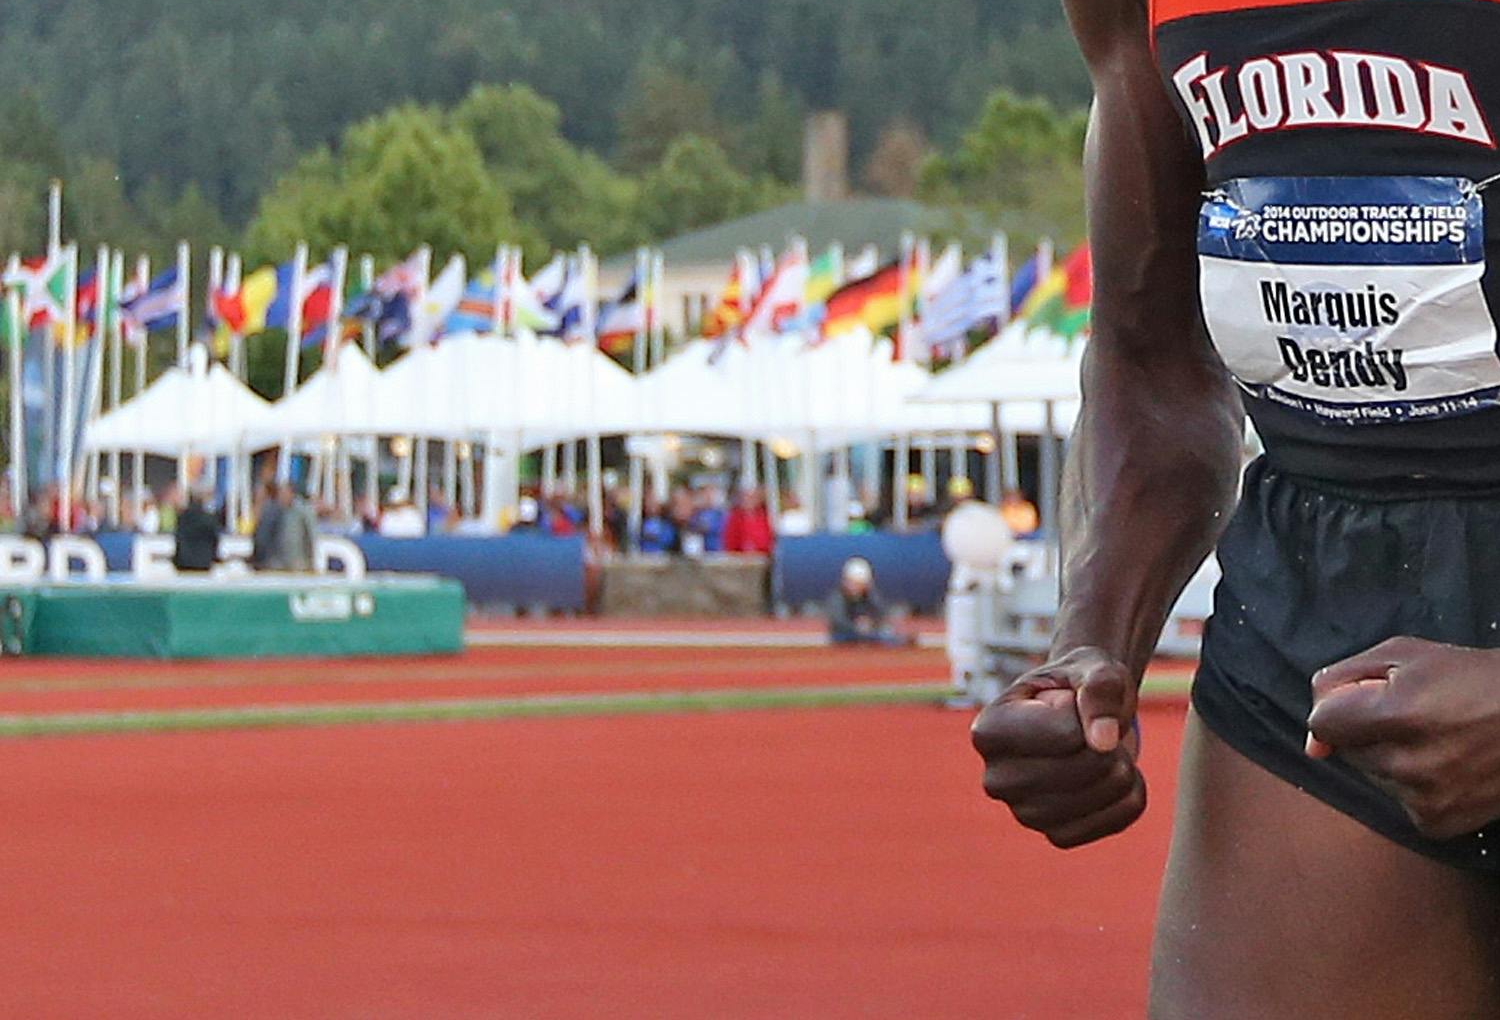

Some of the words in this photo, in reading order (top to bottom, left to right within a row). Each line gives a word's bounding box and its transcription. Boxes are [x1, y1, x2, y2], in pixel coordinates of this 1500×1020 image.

[1173, 50, 1497, 160] FLORIDA
[1263, 206, 1290, 219] 2014
[1293, 206, 1359, 220] OUTDOOR
[1362, 206, 1408, 220] TRACK
[1411, 206, 1420, 219] &
[1424, 206, 1466, 220] FIELD
[1263, 221, 1466, 243] CHAMPIONSHIPS
[1260, 280, 1399, 332] Marquis
[1277, 336, 1407, 391] Dendy
[1408, 403, 1438, 417] June
